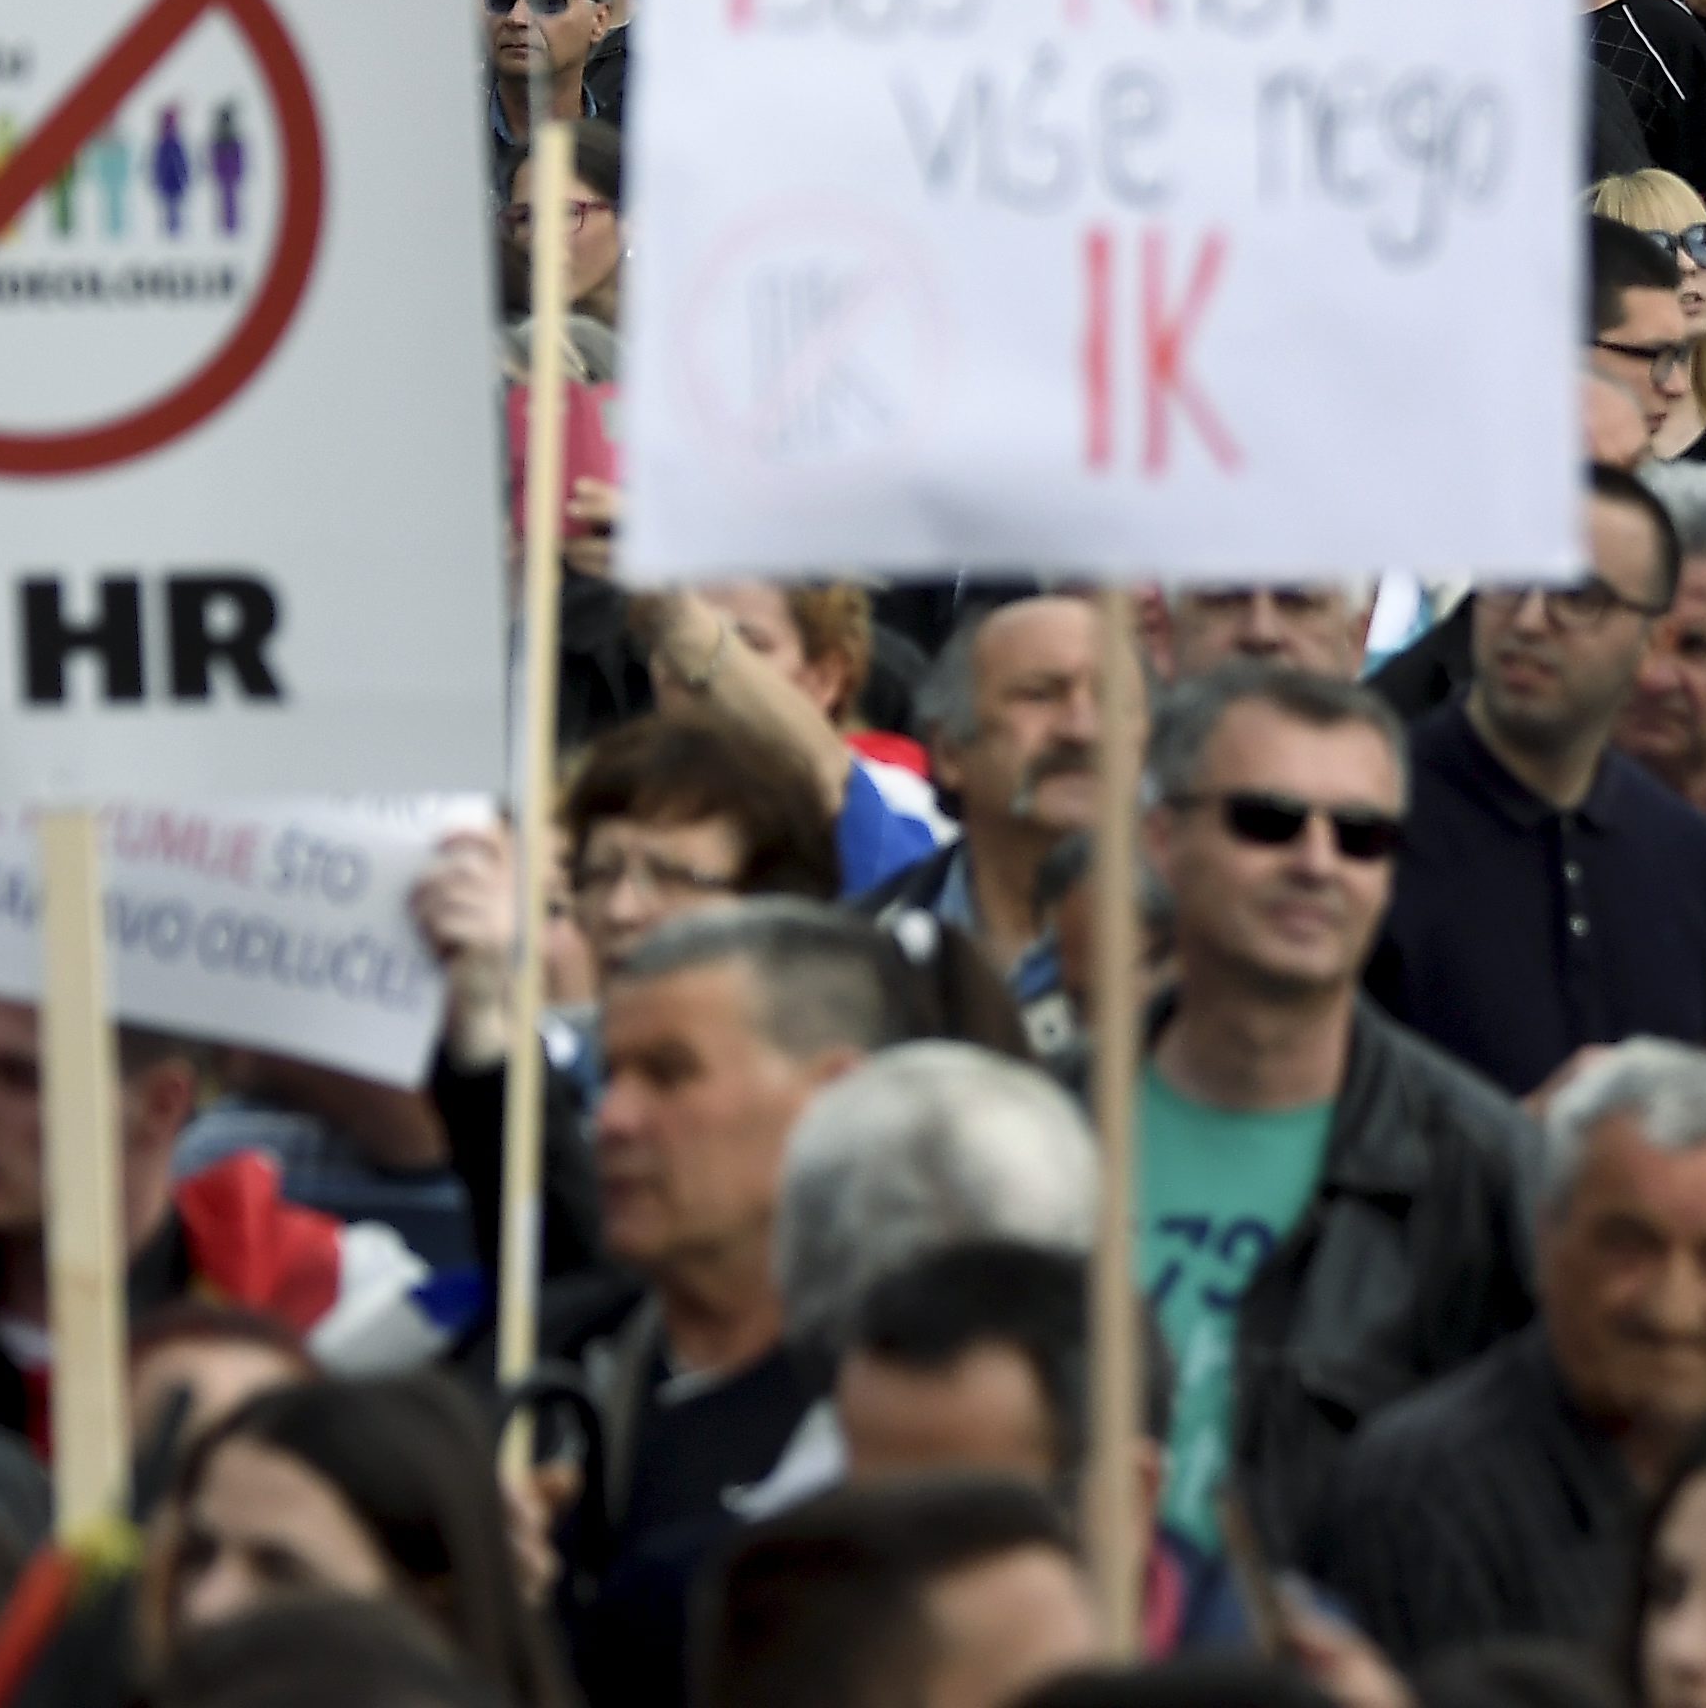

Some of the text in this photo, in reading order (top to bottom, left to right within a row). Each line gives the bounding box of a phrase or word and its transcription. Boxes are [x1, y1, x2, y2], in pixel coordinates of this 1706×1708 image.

[1251, 54, 1519, 274] nego
[1077, 222, 1247, 478] IK
[19, 572, 290, 706] HR
